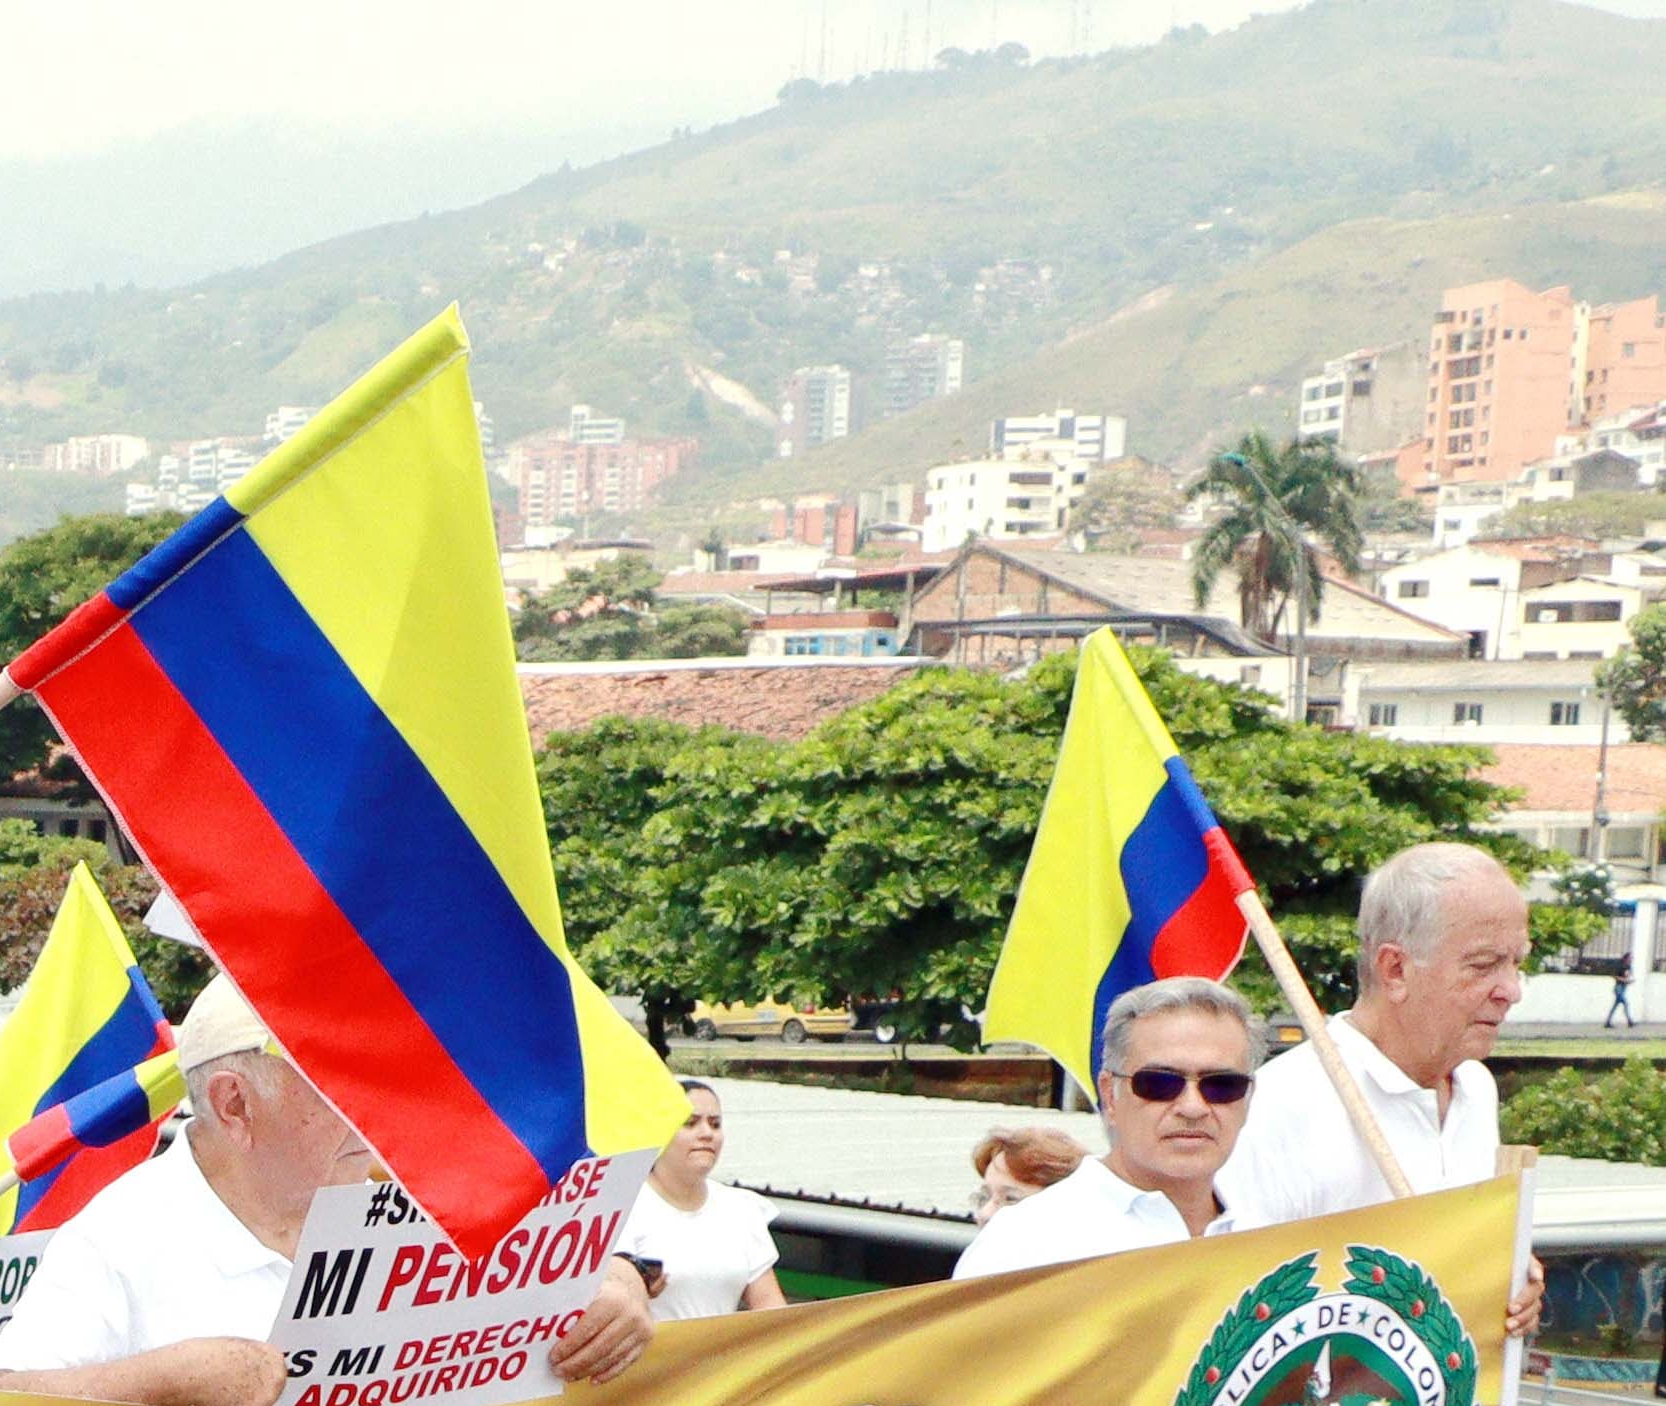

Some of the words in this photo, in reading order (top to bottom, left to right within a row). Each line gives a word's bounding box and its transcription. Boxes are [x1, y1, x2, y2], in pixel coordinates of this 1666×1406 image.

[292, 1247, 374, 1320] MI
[1317, 1302, 1353, 1329] DE
[328, 1345, 386, 1377] MI
